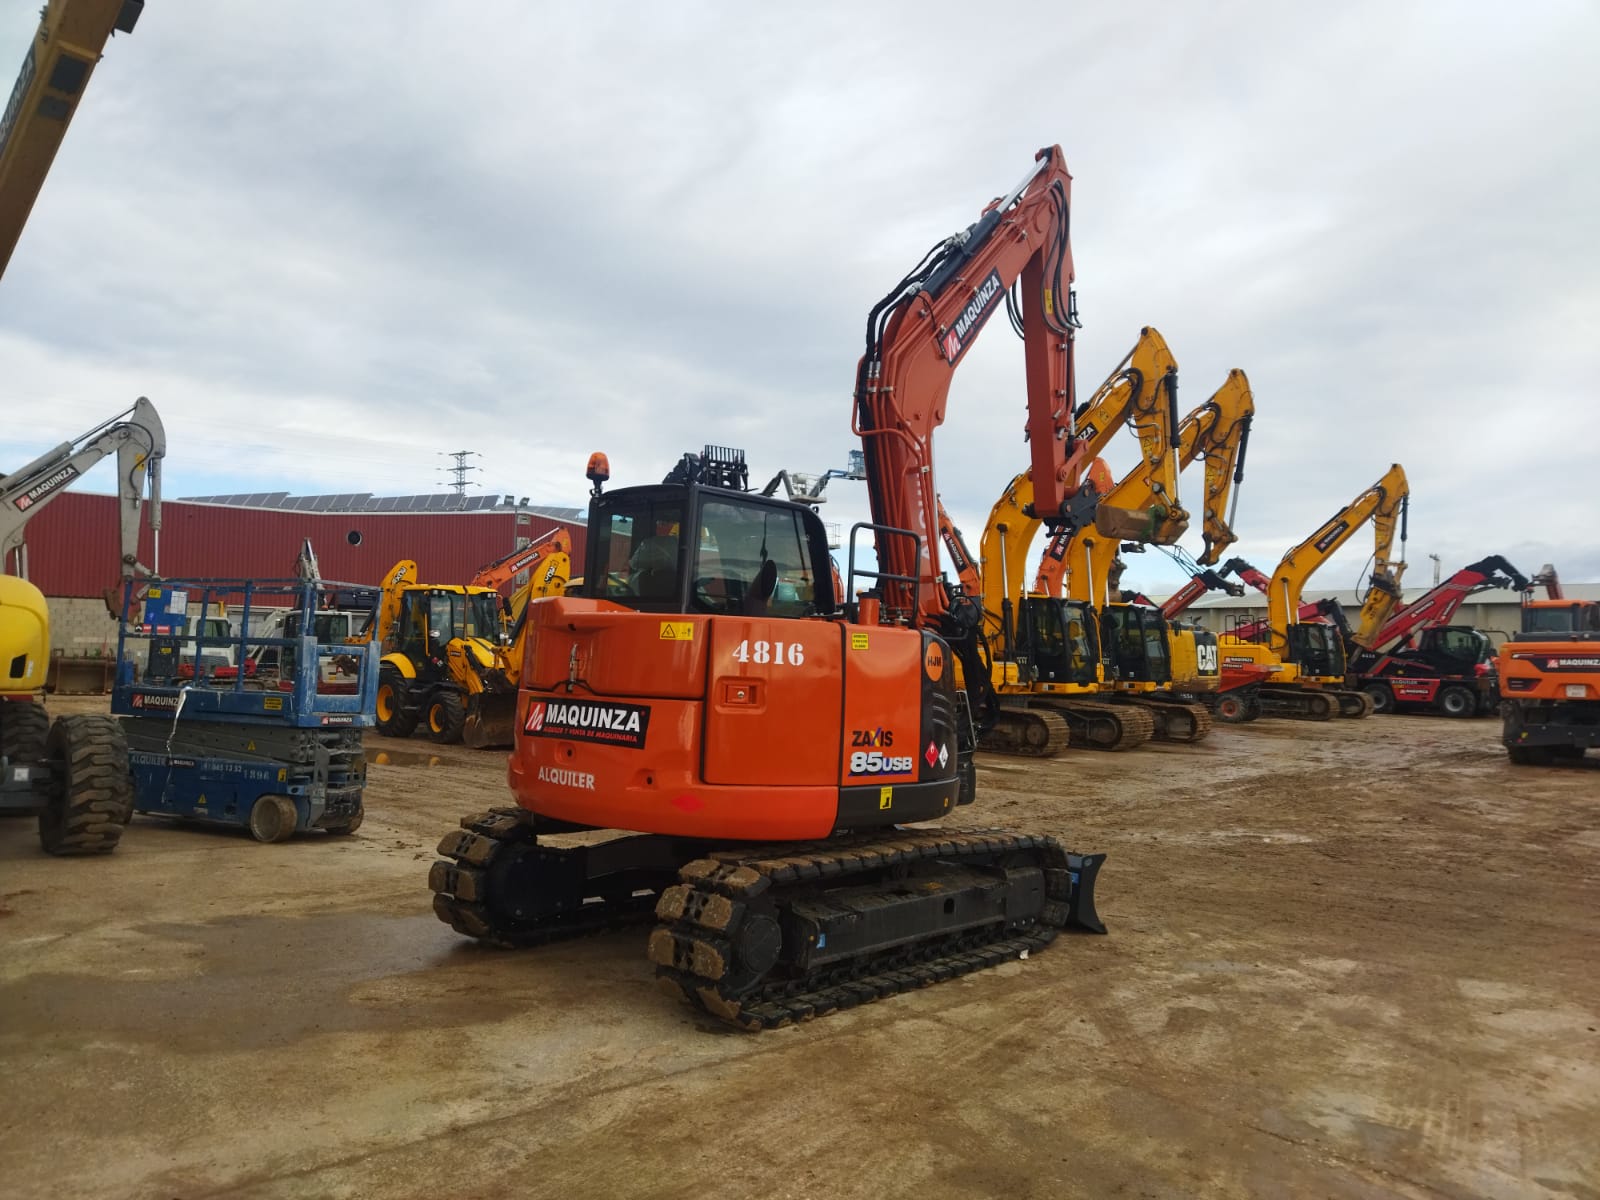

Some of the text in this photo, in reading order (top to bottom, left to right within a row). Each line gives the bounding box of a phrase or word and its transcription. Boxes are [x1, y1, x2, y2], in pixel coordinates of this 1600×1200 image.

[955, 275, 1000, 339] MAQUINZA
[28, 467, 76, 500] MAQUINZA
[732, 639, 805, 666] 4816
[1197, 644, 1218, 671] CAT
[144, 695, 181, 707] MAQUINZ
[545, 703, 640, 733] MAQUINZA
[852, 728, 893, 747] ZAXIS
[538, 766, 596, 791] ALQUILER
